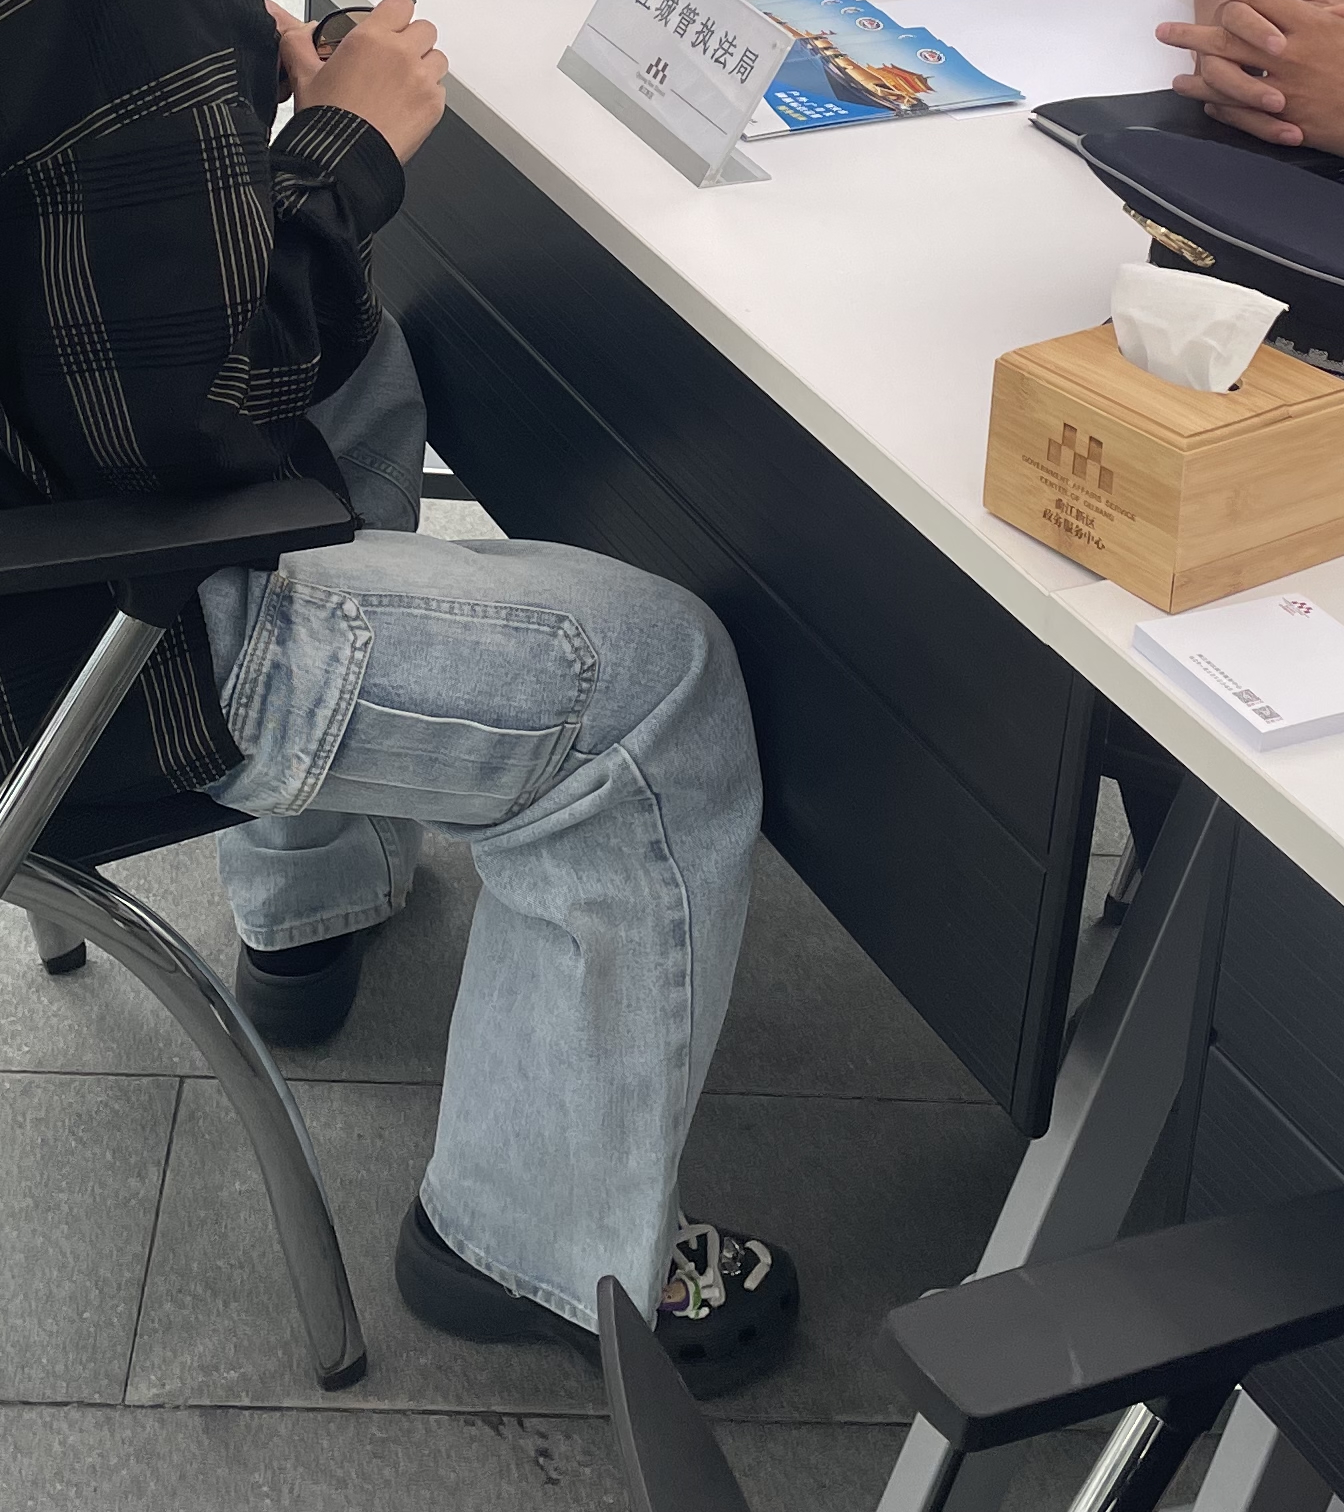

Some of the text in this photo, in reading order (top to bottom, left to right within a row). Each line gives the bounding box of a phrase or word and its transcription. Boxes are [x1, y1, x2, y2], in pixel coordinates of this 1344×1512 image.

[1042, 508, 1105, 550] 政务服务中心
[1055, 498, 1096, 529] 曲江新区
